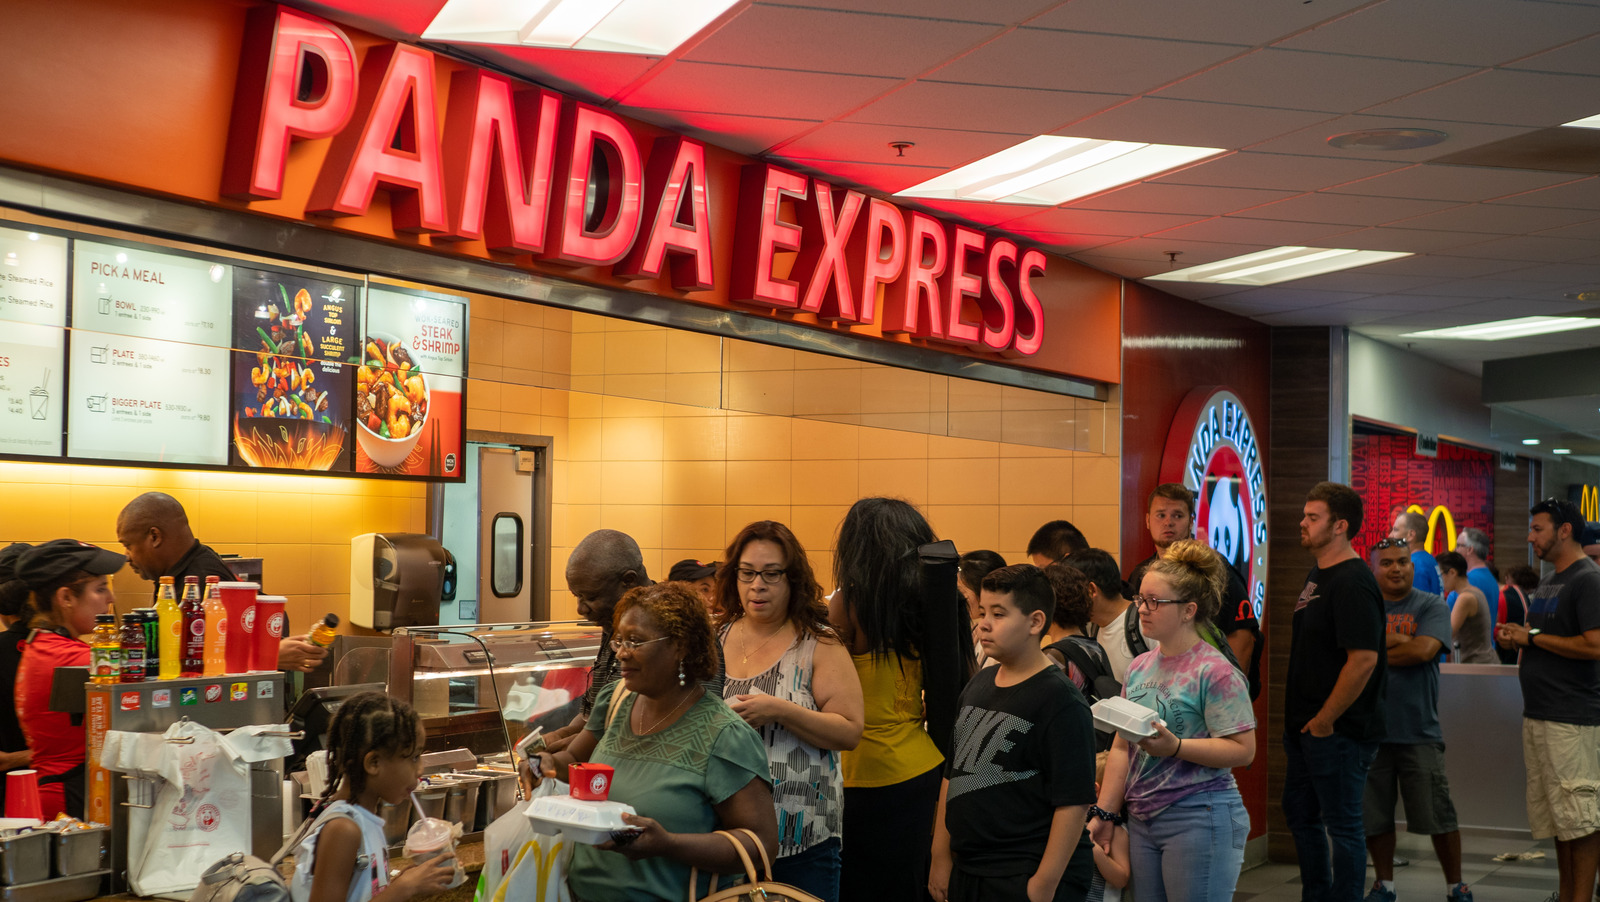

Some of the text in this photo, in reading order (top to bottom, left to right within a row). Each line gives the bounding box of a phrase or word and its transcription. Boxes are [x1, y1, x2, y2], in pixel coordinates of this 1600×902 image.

[240, 6, 1048, 359] PANDA EXPRESS
[91, 261, 165, 285] PICK A MEAL
[8, 273, 37, 285] Steamed
[39, 277, 54, 288] Rice
[8, 295, 37, 307] Steamed
[39, 299, 54, 309] Rice
[115, 300, 137, 311] BOWL
[322, 304, 343, 314] ANGUS
[421, 324, 453, 341] STEAK
[321, 336, 343, 346] LARGE
[112, 349, 135, 360] PLATE
[111, 397, 138, 408] BIGGER
[139, 400, 162, 410] PLATE
[1222, 398, 1268, 548] EXPRESS
[1156, 683, 1172, 699] HIGH
[1167, 698, 1185, 736] SCHOOL
